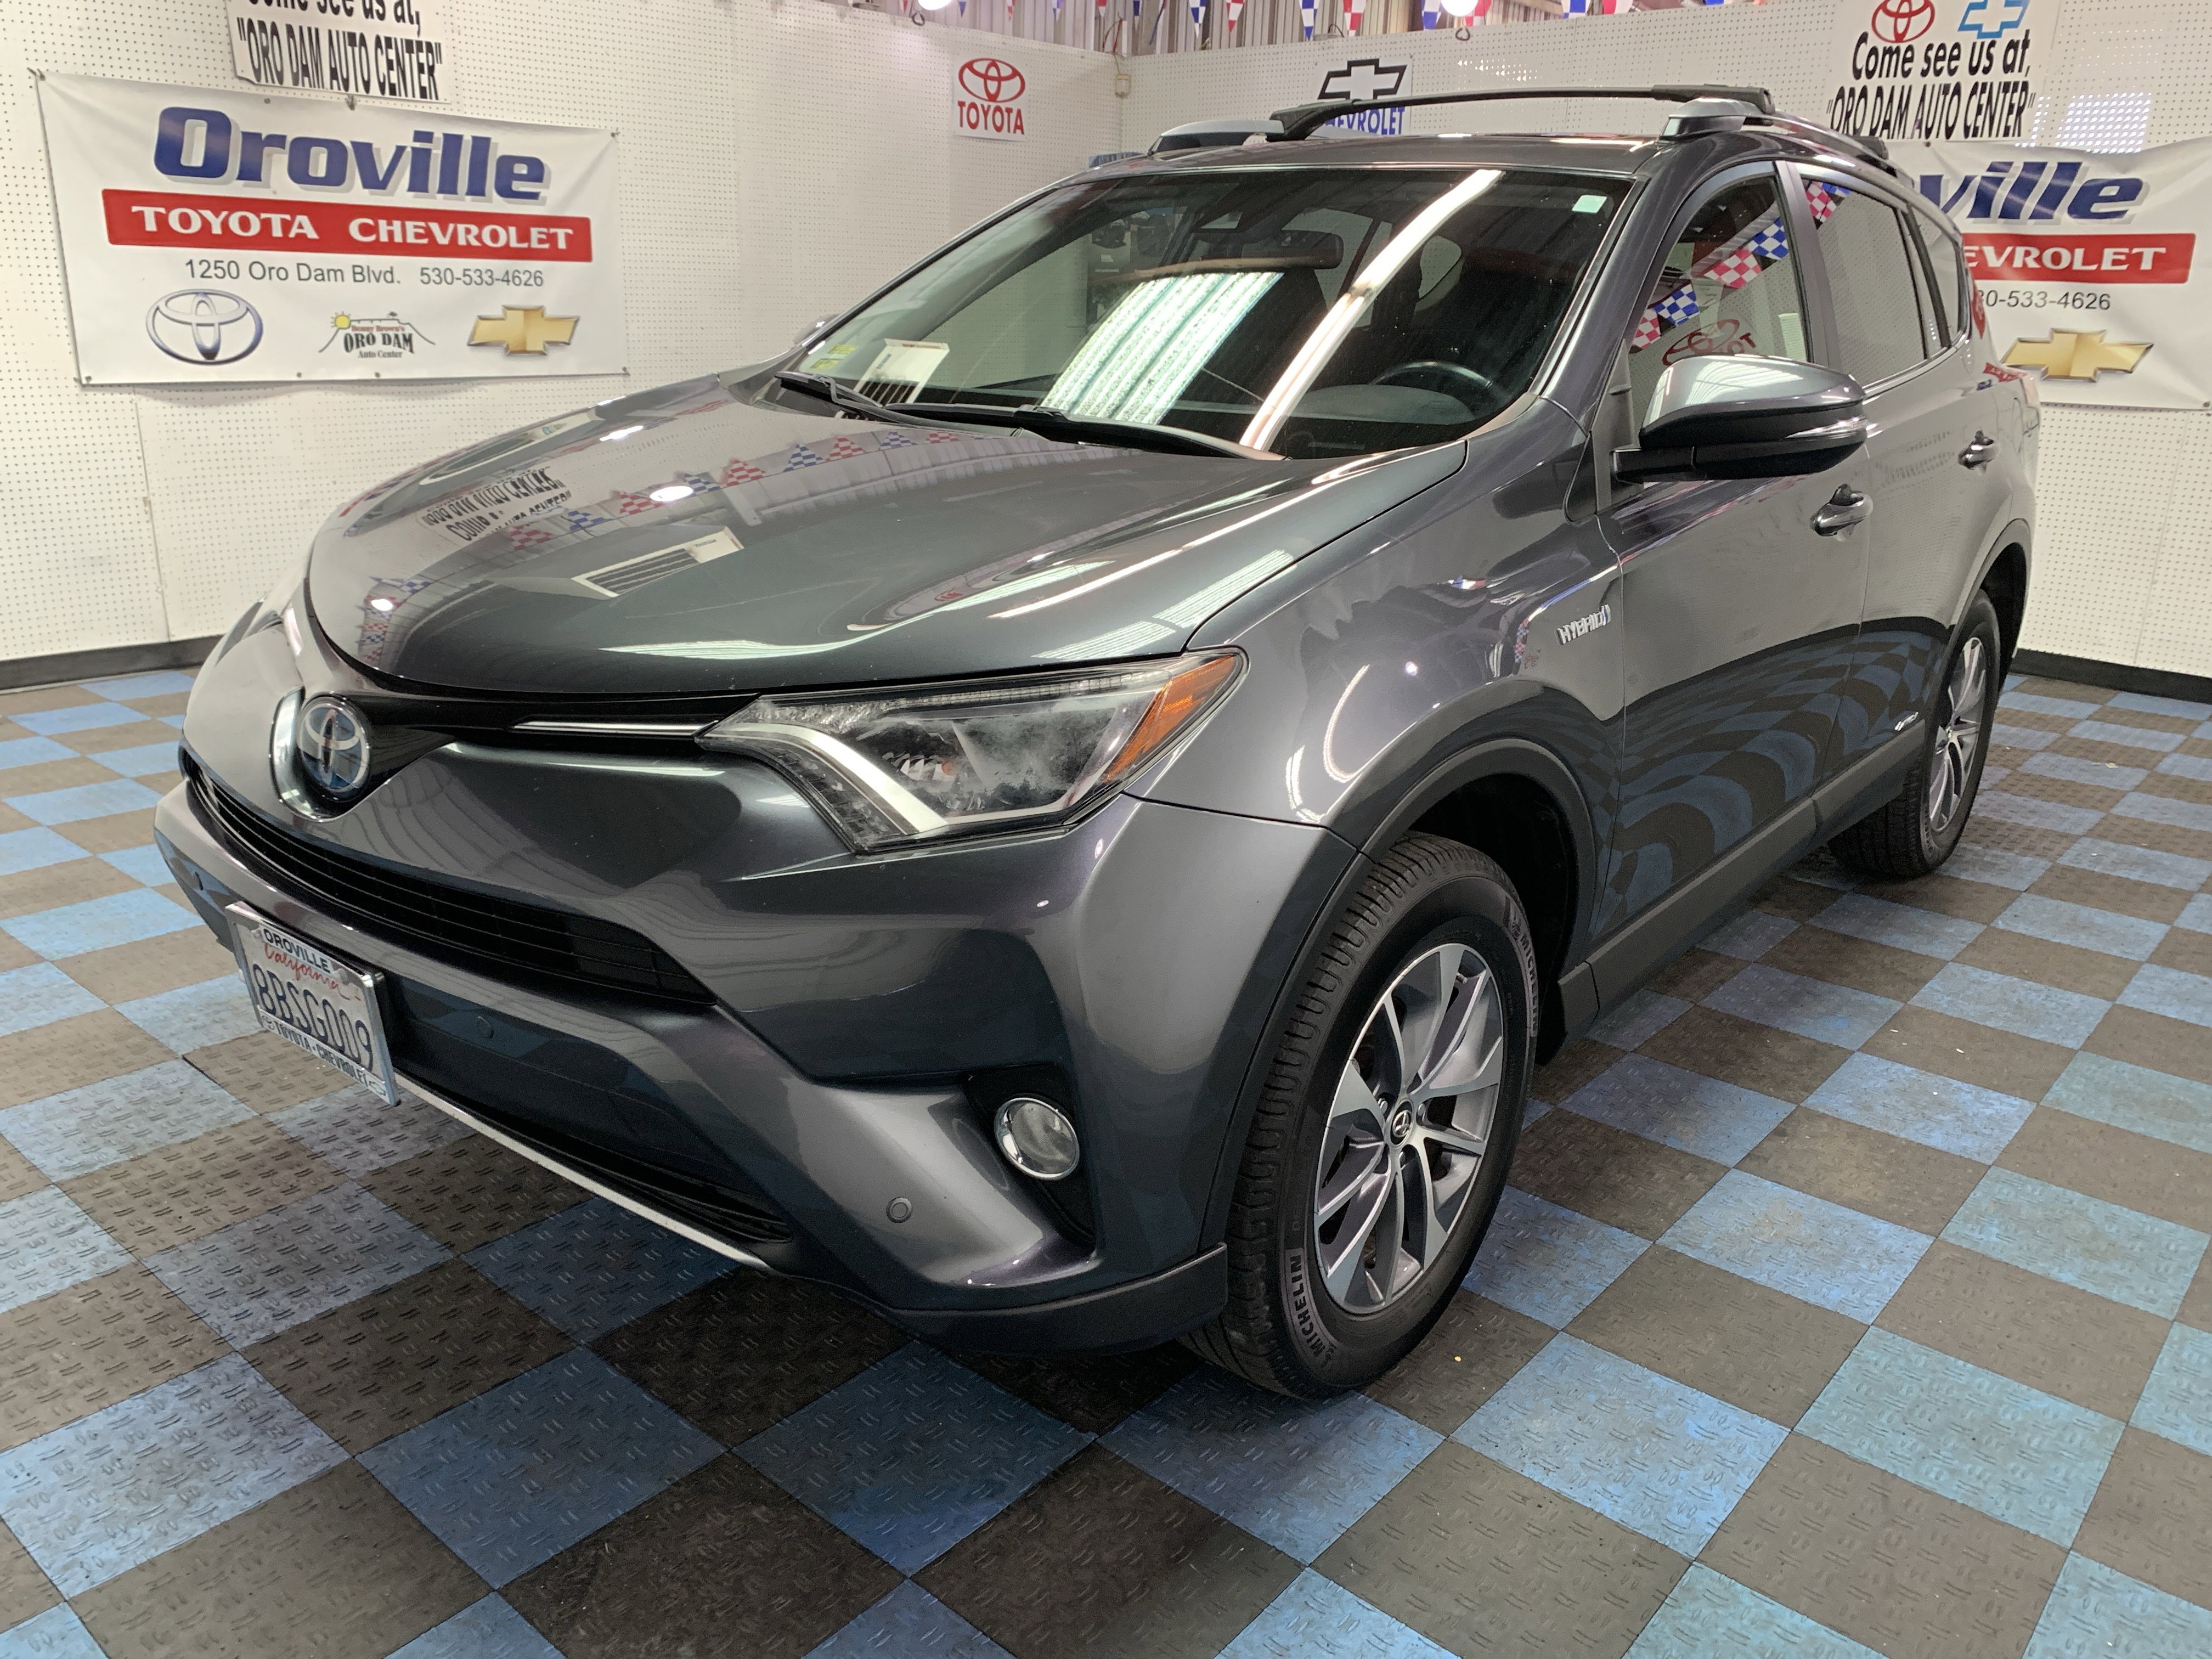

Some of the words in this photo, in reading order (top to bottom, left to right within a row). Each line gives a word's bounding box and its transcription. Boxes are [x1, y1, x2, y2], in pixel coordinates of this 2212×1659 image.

[237, 17, 284, 86] "ORO
[285, 23, 325, 89] DAM
[328, 28, 370, 94] AUTO
[374, 33, 443, 101] CENTER"
[1852, 31, 1915, 80] Come
[1920, 41, 1962, 78] see
[1968, 39, 1997, 76] us
[2002, 29, 2031, 78] at,
[957, 100, 1025, 136] TOYOTA
[1325, 106, 1406, 135] VROLET
[1869, 84, 1912, 139] DAM
[1910, 81, 1962, 139] AUTO
[1963, 80, 2037, 140] CENTER"
[154, 106, 546, 201] Oroville
[1919, 161, 2144, 221] ville
[131, 205, 319, 240] TOYOTA
[348, 217, 573, 250] CHEVROLET
[184, 259, 240, 280] 1250
[249, 261, 289, 281] Oro
[296, 262, 345, 283] Dam
[352, 263, 401, 285] Blvd.
[420, 266, 544, 287] 530-533-4626
[1963, 245, 2166, 271] EVROLET
[1978, 289, 2112, 311] 0-533-4626
[343, 332, 376, 353] ORO
[381, 332, 415, 354] DAM
[358, 350, 376, 358] Auto
[377, 350, 403, 358] Center
[1558, 611, 1604, 644] HYBRID
[263, 928, 330, 974] OROVILLE
[253, 963, 373, 1072] 8BSG009
[274, 1020, 312, 1052] TOYOTA
[1289, 1255, 1326, 1357] MICHELIN
